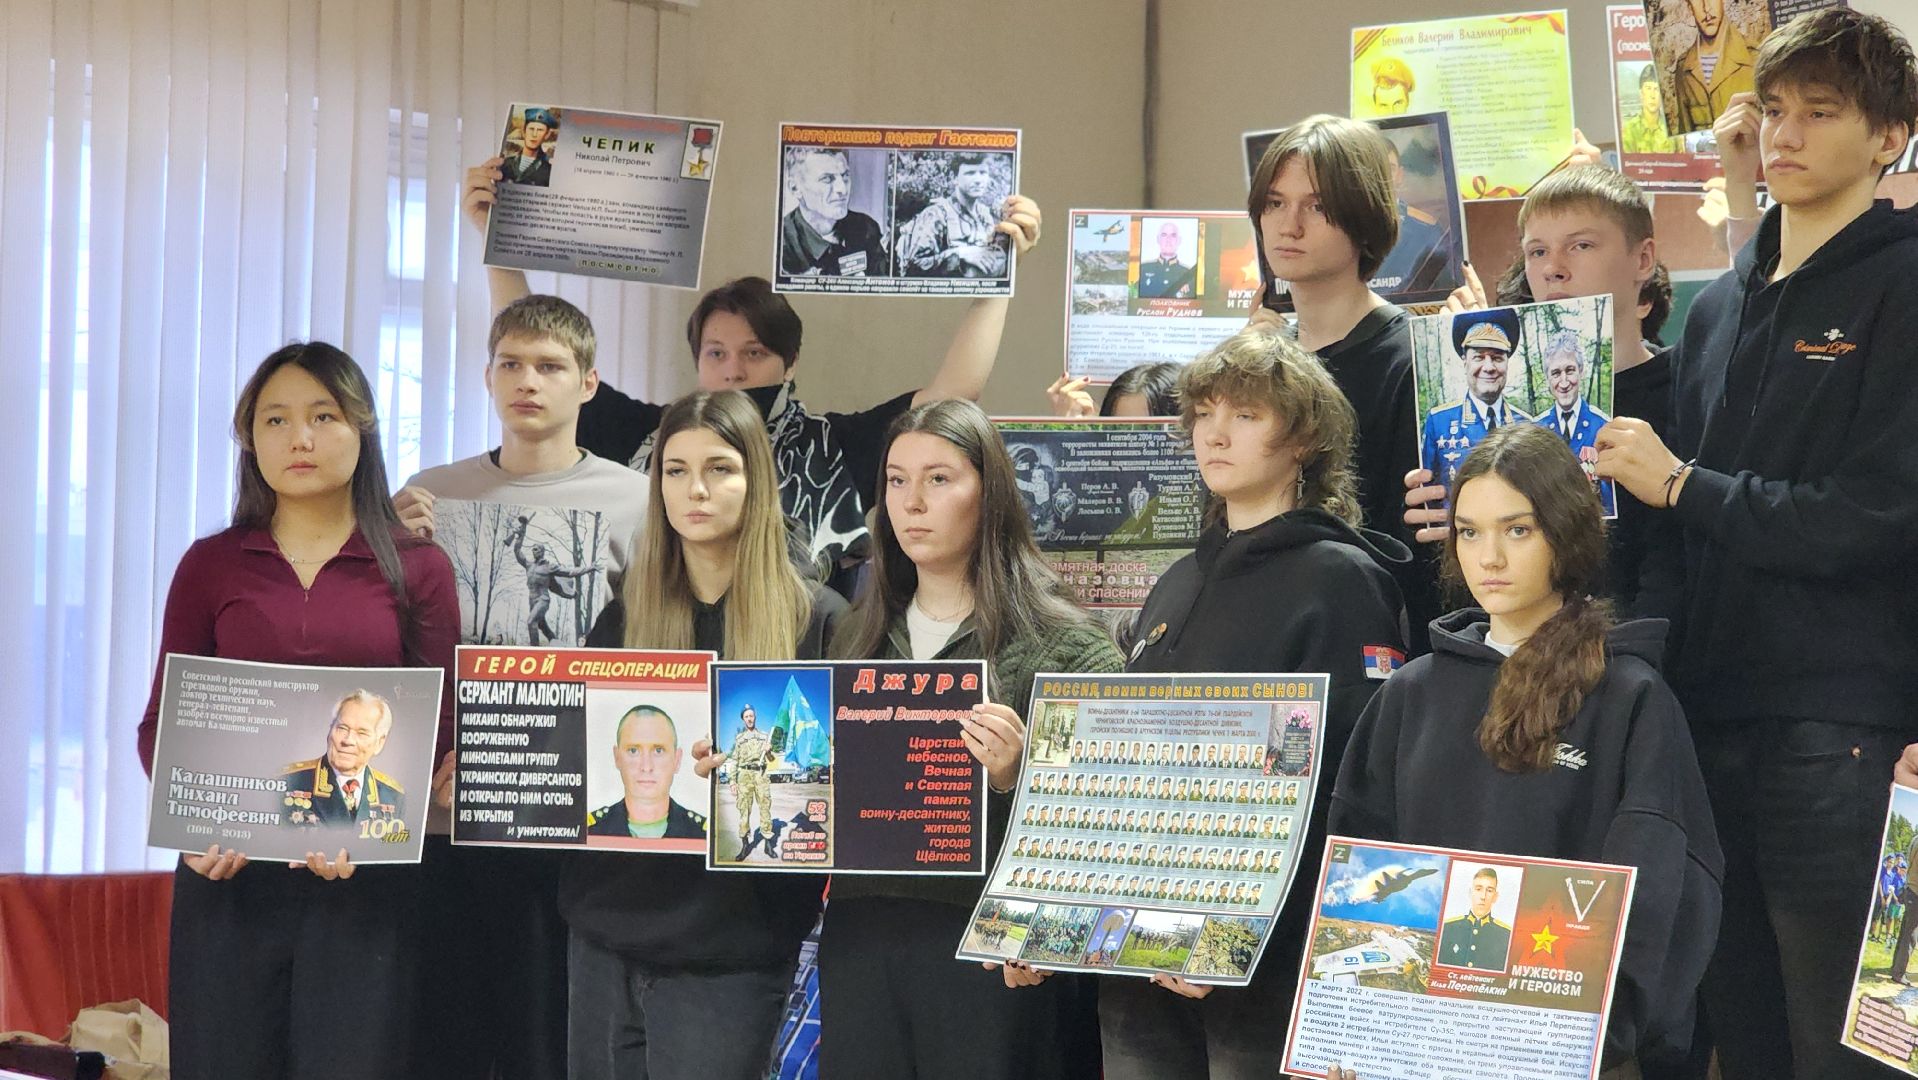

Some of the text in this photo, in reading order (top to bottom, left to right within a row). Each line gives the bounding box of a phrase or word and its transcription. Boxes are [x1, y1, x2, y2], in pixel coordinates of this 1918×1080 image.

[782, 126, 1017, 147] Повторившие подвиг Гастелло
[582, 136, 656, 154] ЧЕПИК
[575, 151, 651, 167] Николай Петрович
[1052, 562, 1147, 574] амятная доска
[473, 653, 700, 679] ГЕРОЙ СПЕЦОПЕРАЦИИ
[181, 680, 227, 693] стрелкового
[182, 670, 221, 683] Советский
[229, 677, 272, 688] российский
[273, 681, 319, 692] конструктор
[853, 668, 979, 695] Джура
[458, 681, 514, 704] СЕРЖАНТ
[516, 682, 585, 707] МАЛЮТИН
[1103, 686, 1146, 697] помни
[1204, 685, 1248, 698] своих
[1252, 682, 1313, 699] СЫНОВ!
[180, 691, 207, 701] доктор
[209, 694, 255, 705] технических
[461, 713, 557, 727] МИХАИЛ ОБНАРУЖИЛ
[836, 706, 892, 722] Валерий
[208, 721, 259, 734] Калашникова
[248, 717, 288, 727] известный
[461, 732, 529, 746] ВООРУЖЕННУЮ
[909, 736, 965, 750] Царстви
[460, 752, 560, 766] МИНОМЕТАМИ ГРУППУ
[907, 750, 971, 764] небесное,
[924, 765, 972, 777] Вечная
[170, 766, 288, 792] Калашников
[460, 770, 582, 787] УКРАИНСКИХ ДИВЕРСАНТОВ
[905, 779, 972, 791] и Светлая
[169, 783, 239, 805] Михаил
[460, 791, 574, 806] И ОТКРЫЛ ПО НИМ ОГОНЬ
[923, 795, 972, 805] память
[167, 800, 280, 825] Тимофеевич
[807, 801, 827, 814] 52
[459, 810, 514, 823] ИЗ УКРЫТИЯ
[860, 809, 971, 821] воину-десантнику,
[359, 818, 405, 839] 100
[923, 823, 971, 834] жителю
[929, 837, 971, 849] города
[915, 850, 971, 863] Щёлково
[1511, 964, 1584, 983] МУЖЕСТВО
[1346, 986, 1363, 996] 2022
[1374, 992, 1408, 1002] совершил
[1447, 980, 1508, 996] Перепёлкин
[1508, 979, 1582, 997] И ГЕРОИЗМ
[1307, 998, 1344, 1010] Выполняя
[1308, 991, 1348, 1002] подготовки
[1350, 998, 1409, 1010] истребительного
